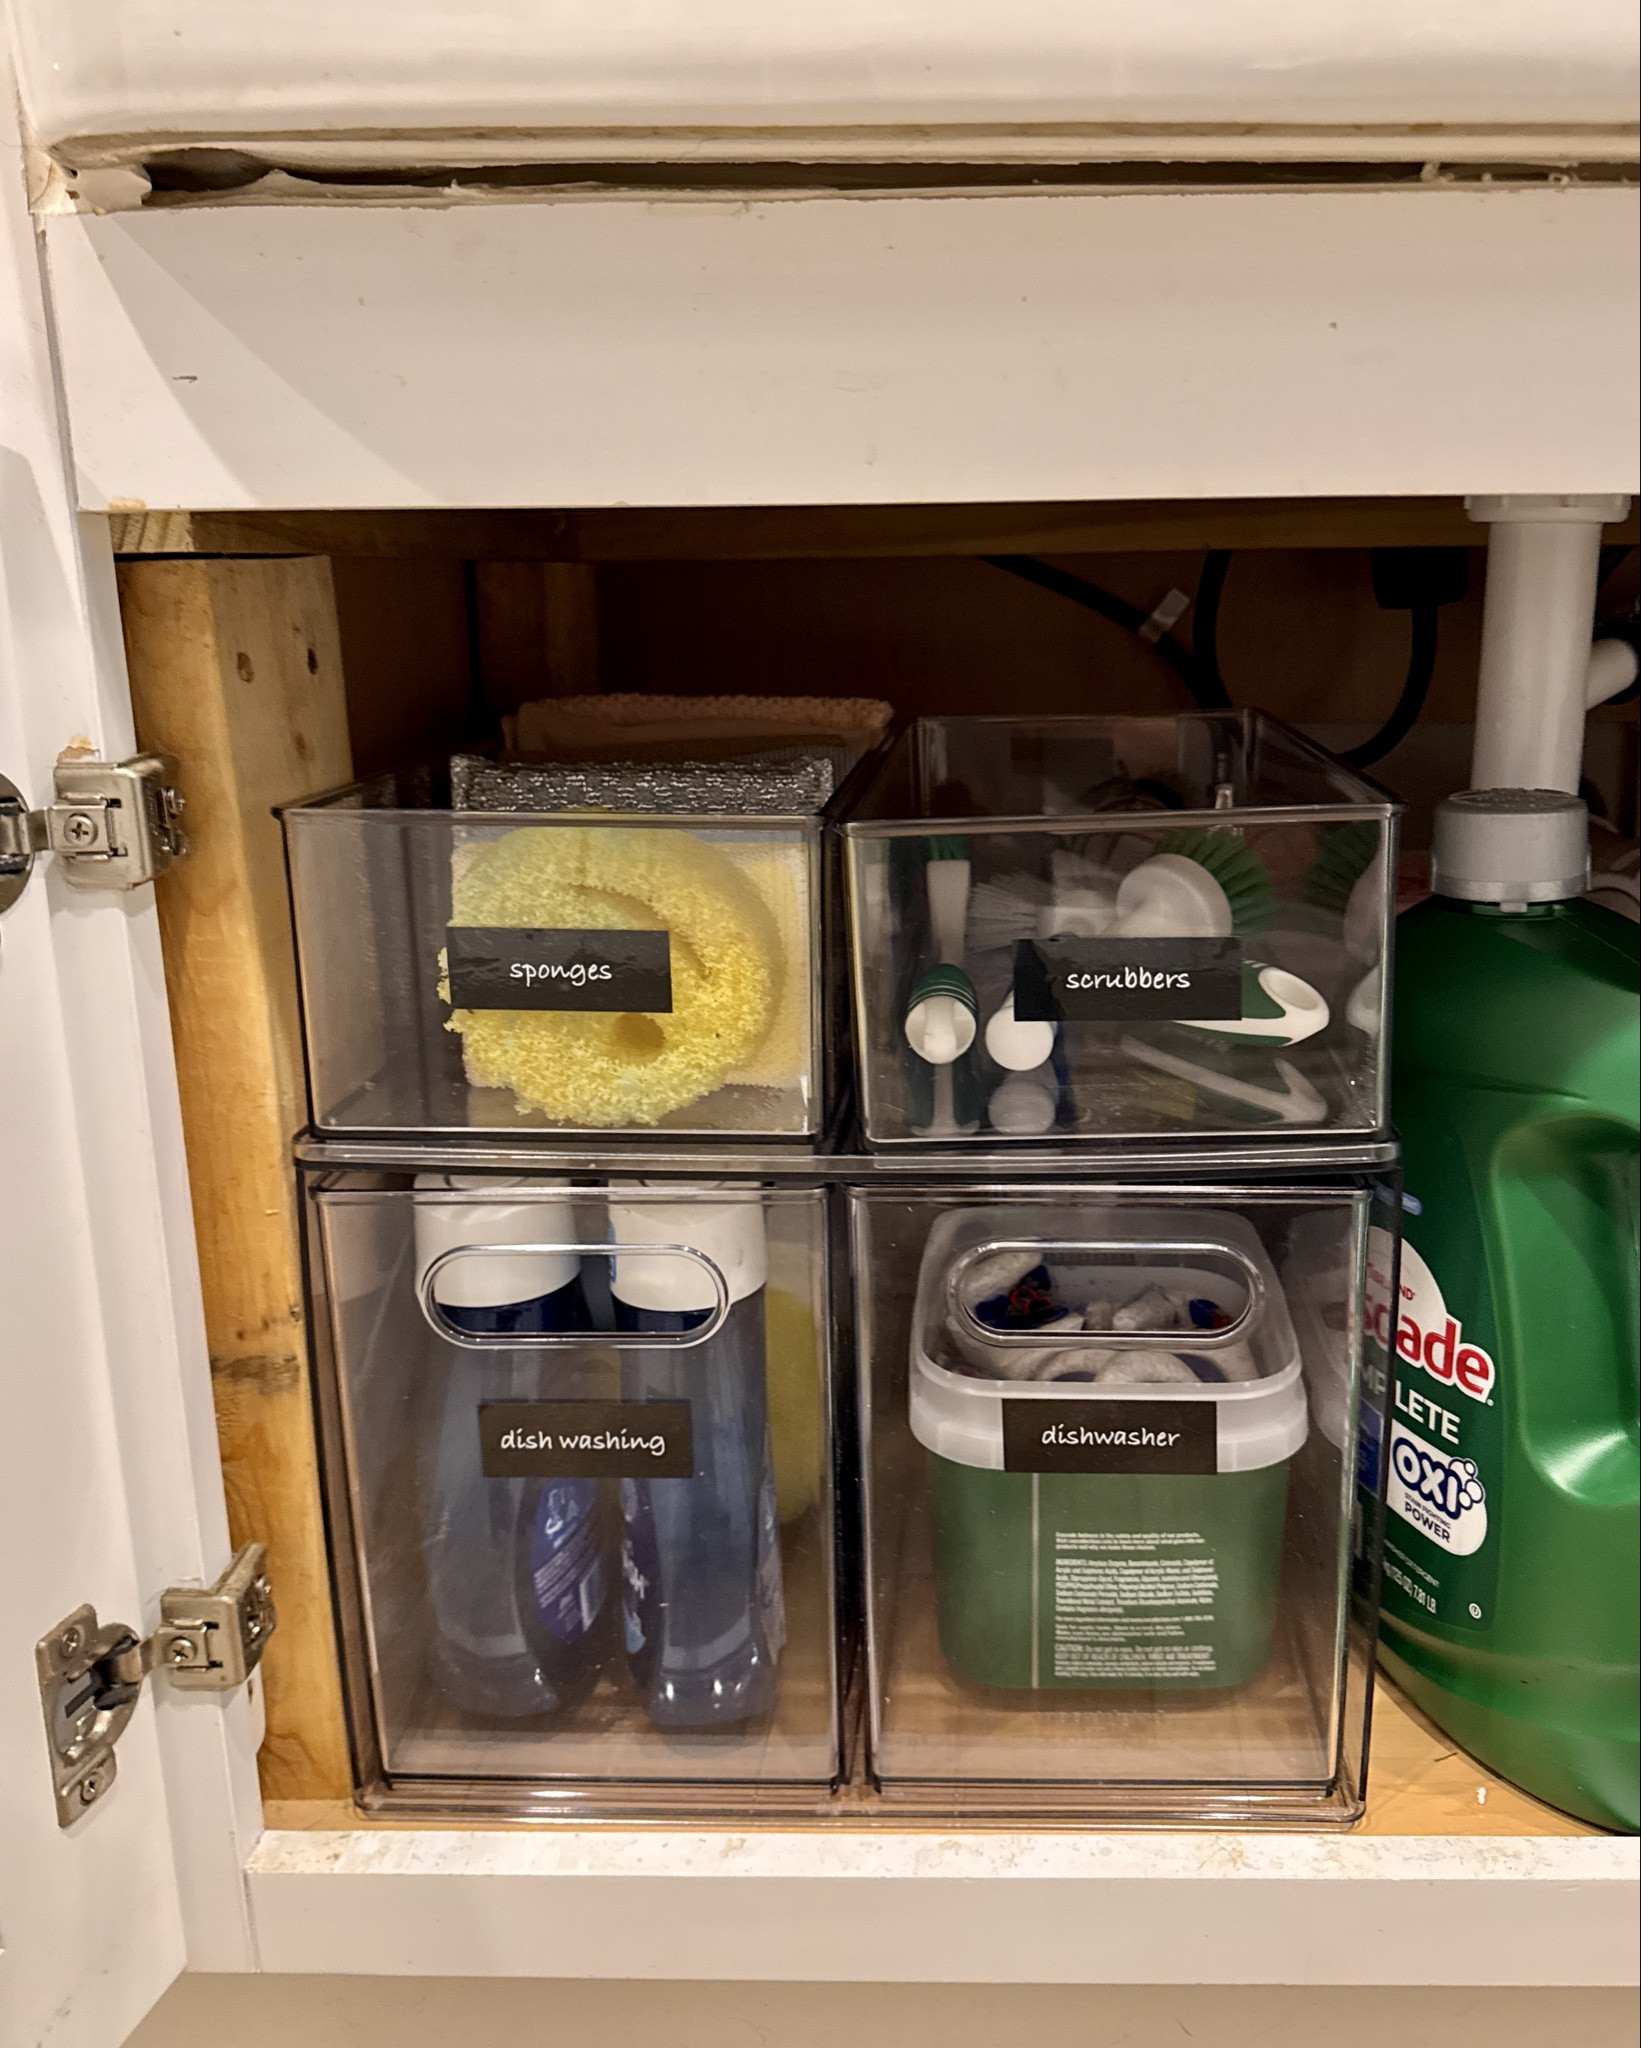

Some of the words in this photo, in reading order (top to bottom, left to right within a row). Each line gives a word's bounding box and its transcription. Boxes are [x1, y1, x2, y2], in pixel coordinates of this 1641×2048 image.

[509, 963, 612, 987] sponges
[1065, 966, 1191, 989] scrubbers
[500, 1428, 553, 1450] dish
[559, 1428, 666, 1456] washing
[1041, 1423, 1181, 1447] dishwasher
[1394, 1438, 1461, 1519] OXI
[1404, 1501, 1450, 1543] POWER
